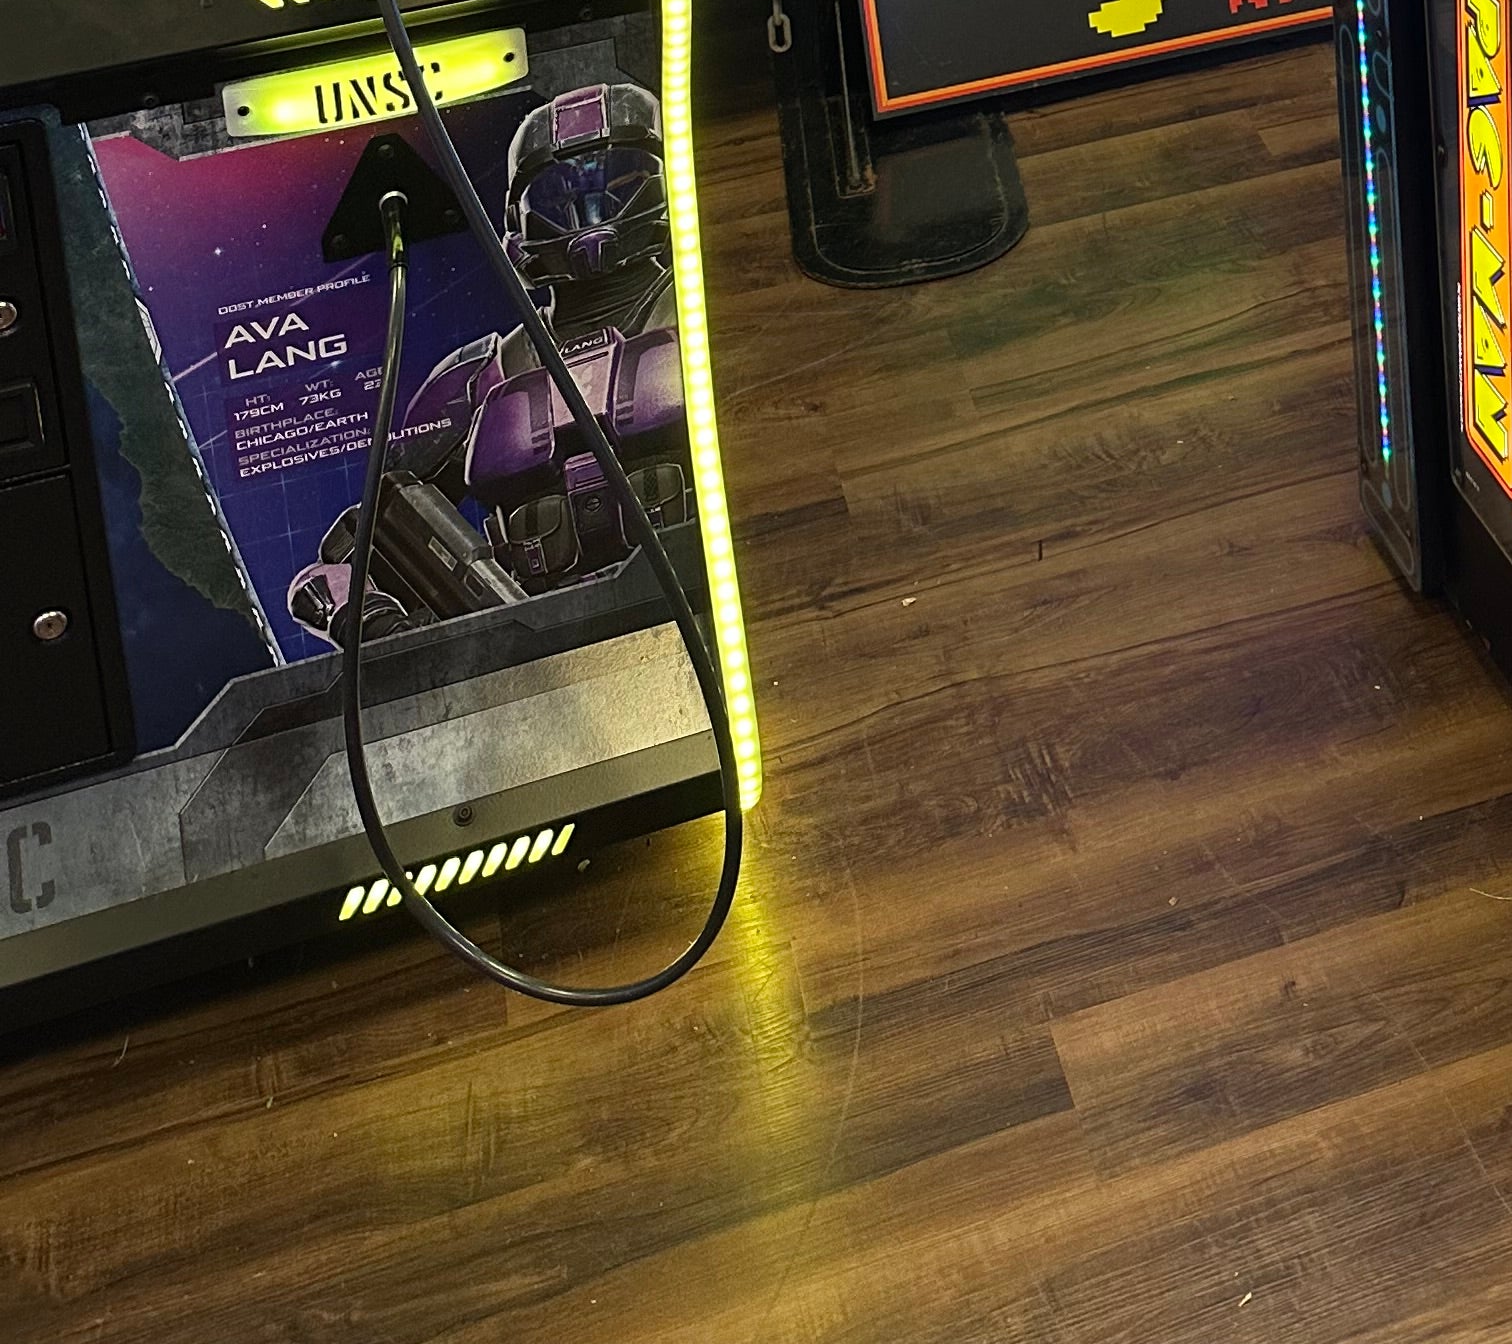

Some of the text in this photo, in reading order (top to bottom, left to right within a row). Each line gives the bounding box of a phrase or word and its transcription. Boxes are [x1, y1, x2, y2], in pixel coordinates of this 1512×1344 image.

[256, 287, 314, 308] MEMBER
[316, 274, 371, 293] PROFILE
[223, 312, 310, 349] AVA
[228, 333, 347, 379] LANG
[233, 402, 285, 421] 179CM
[299, 389, 342, 406] 73KG
[244, 393, 271, 407] HT:
[304, 379, 334, 392] WT:
[234, 407, 339, 439] BIRTHPLACE:
[236, 411, 369, 451] CHICAGO/EARTH
[238, 427, 371, 466] SPECIALIZATION:
